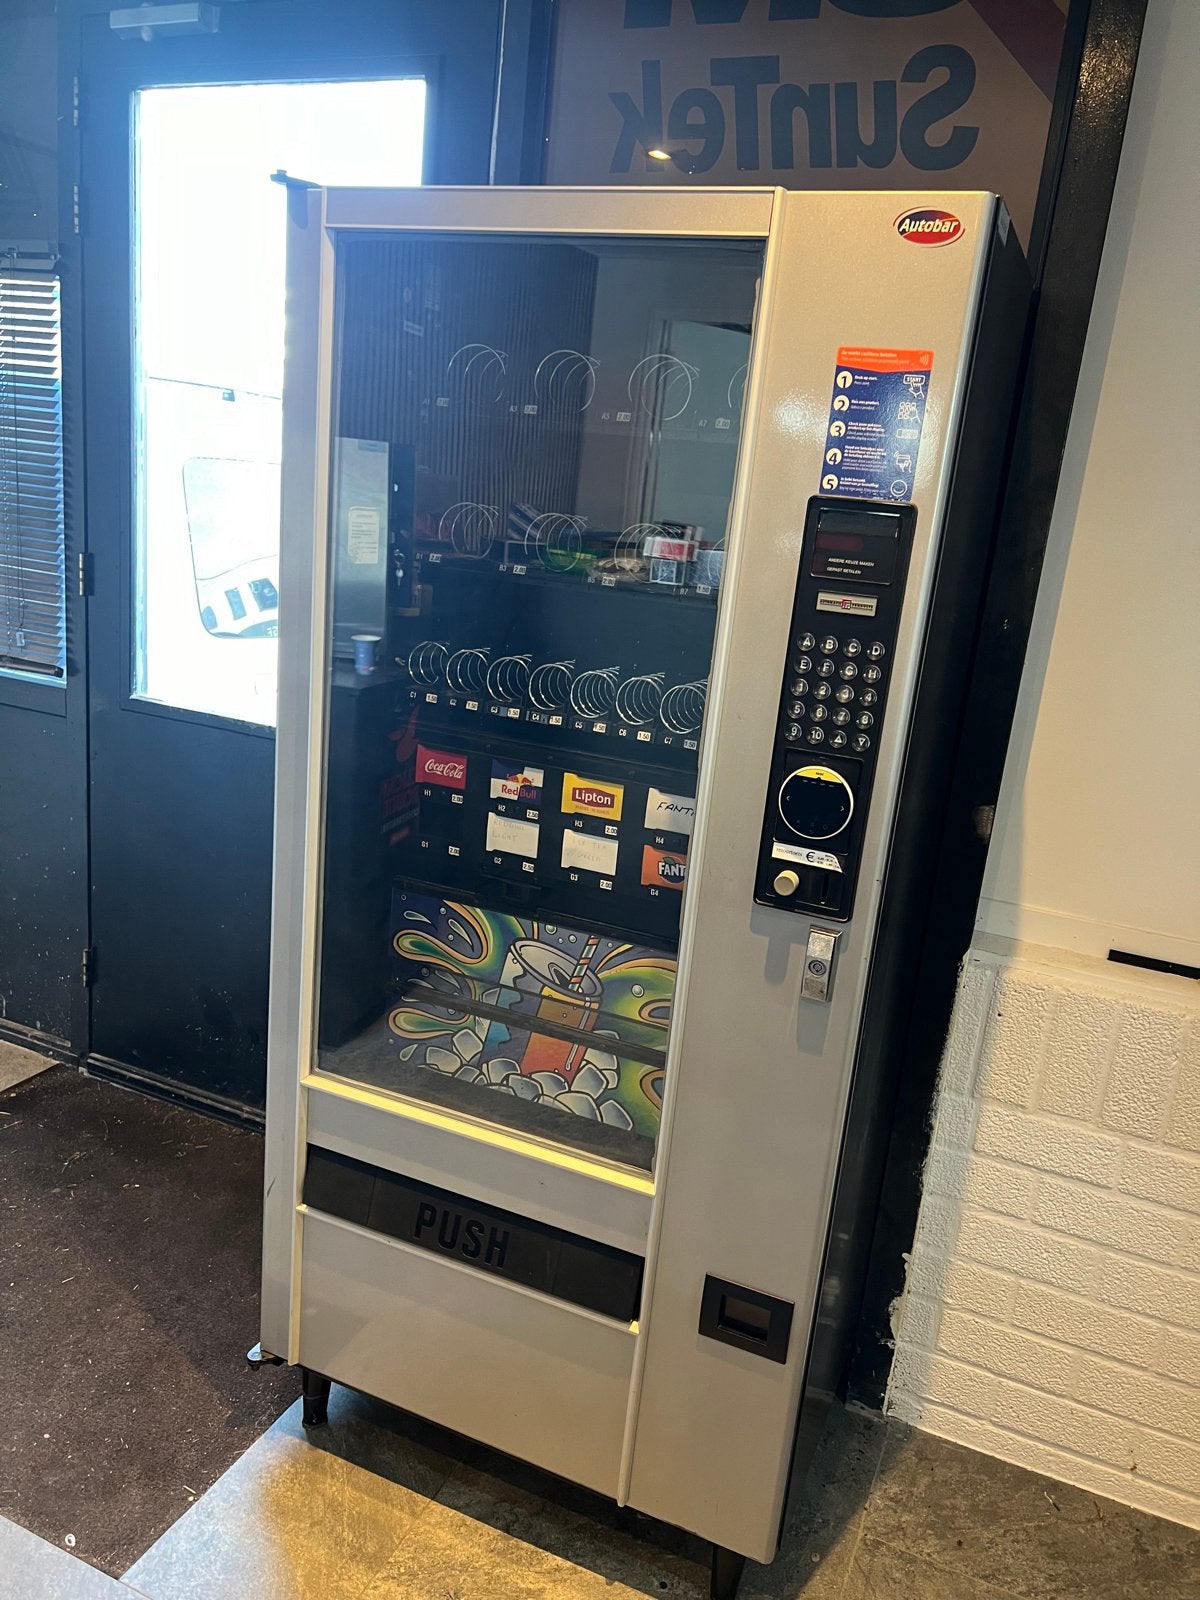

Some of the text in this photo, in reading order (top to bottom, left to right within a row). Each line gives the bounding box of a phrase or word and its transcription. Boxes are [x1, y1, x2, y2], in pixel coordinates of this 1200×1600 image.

[899, 218, 959, 233] Autobar
[841, 375, 847, 388] 1
[837, 400, 846, 412] 2
[834, 425, 842, 437] 3
[828, 451, 838, 465] 4
[826, 478, 834, 490] 5
[802, 637, 880, 655] A B C D
[800, 659, 877, 679] E F G H
[410, 691, 417, 699] C1
[819, 686, 827, 696] 2
[843, 689, 849, 699] 3
[865, 692, 872, 702] 4
[508, 709, 519, 717] 1.50
[532, 713, 539, 721] C4
[794, 704, 869, 725] 5 6 7 8
[575, 721, 605, 732] C5 1.50
[791, 726, 822, 738] 9 10
[619, 728, 650, 740] C6 1.50
[664, 737, 696, 749] C7 1.50
[424, 789, 463, 803] H1 2.00
[501, 784, 537, 800] Red Bull
[575, 789, 611, 805] Lipton
[498, 804, 538, 819] H2 2.50
[656, 802, 695, 817] FANT
[574, 820, 617, 835] H3 2.00
[655, 836, 664, 845] H4
[494, 857, 534, 871] G2 2.50
[658, 861, 686, 877] FANT
[570, 873, 612, 889] G3 2.00
[650, 888, 659, 896] G4
[412, 1202, 510, 1269] PUSH
